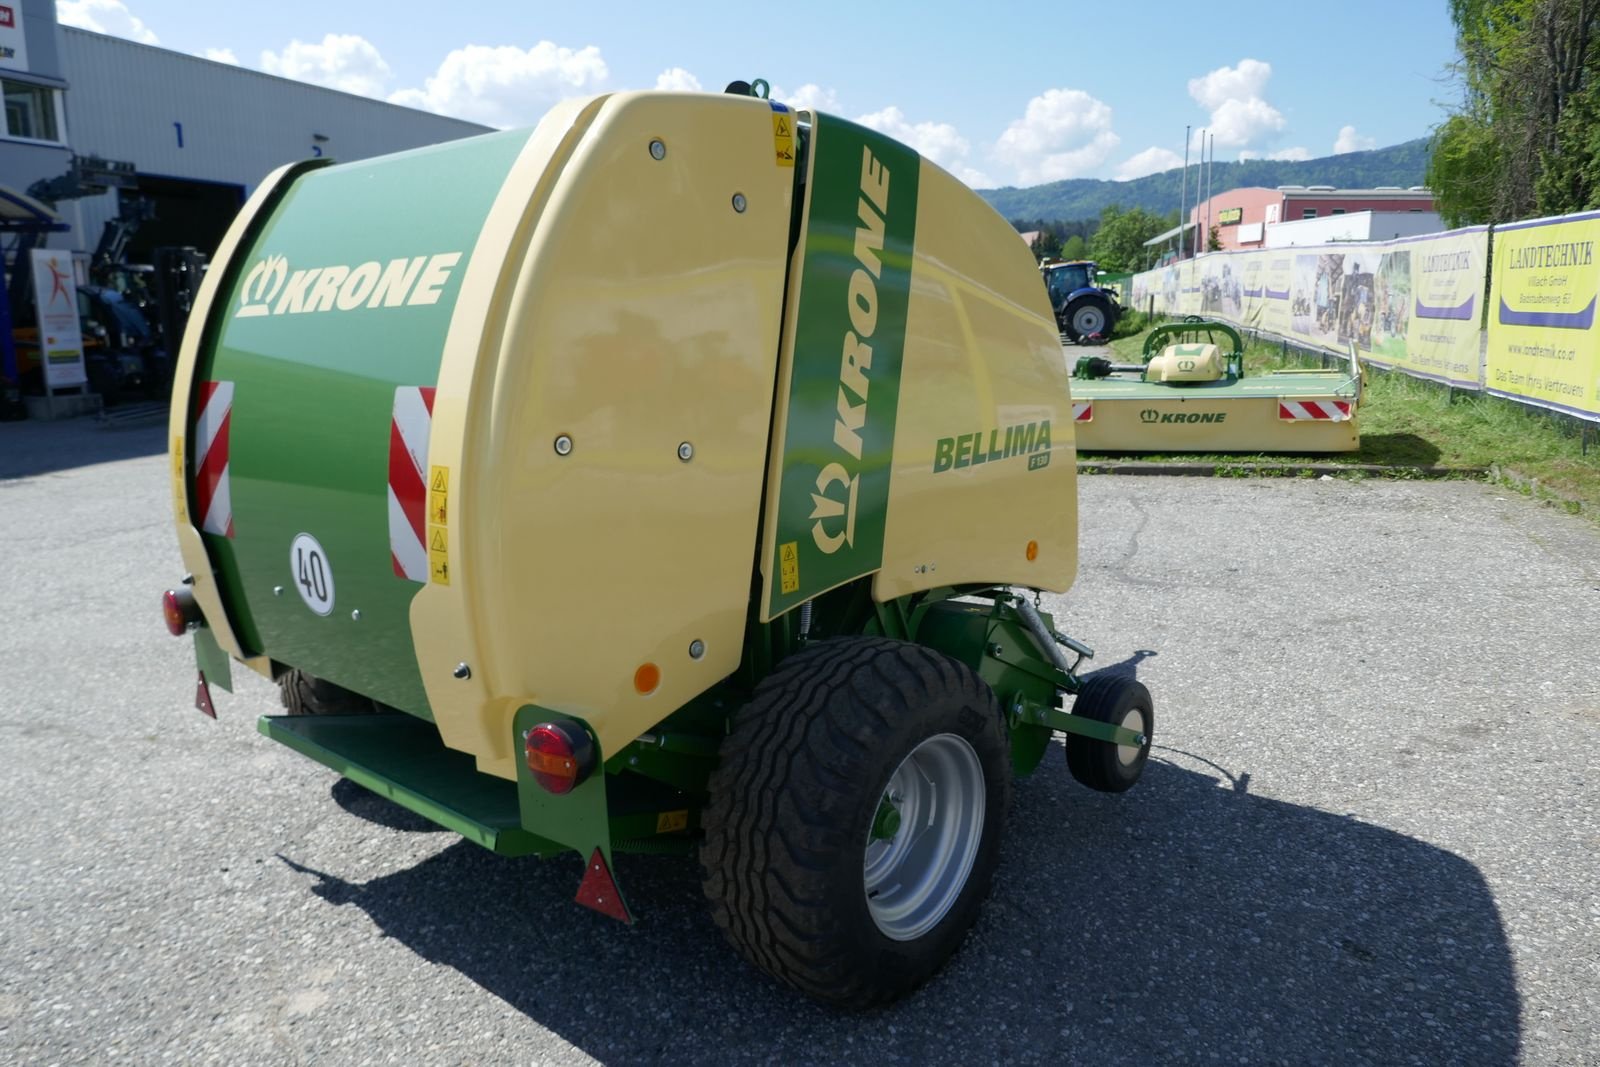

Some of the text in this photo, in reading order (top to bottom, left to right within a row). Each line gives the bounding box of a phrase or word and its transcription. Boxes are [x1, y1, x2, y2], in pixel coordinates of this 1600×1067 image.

[173, 121, 184, 149] 1
[1509, 241, 1594, 270] LANDTECHNIK
[274, 251, 463, 315] KRONE
[833, 144, 890, 460] KRONE
[1496, 368, 1507, 382] Das
[1508, 370, 1525, 385] Team
[1544, 376, 1584, 398] Vertrauens
[1160, 412, 1227, 424] KRONE
[933, 420, 1051, 473] BELLIMA
[297, 547, 328, 603] 40
